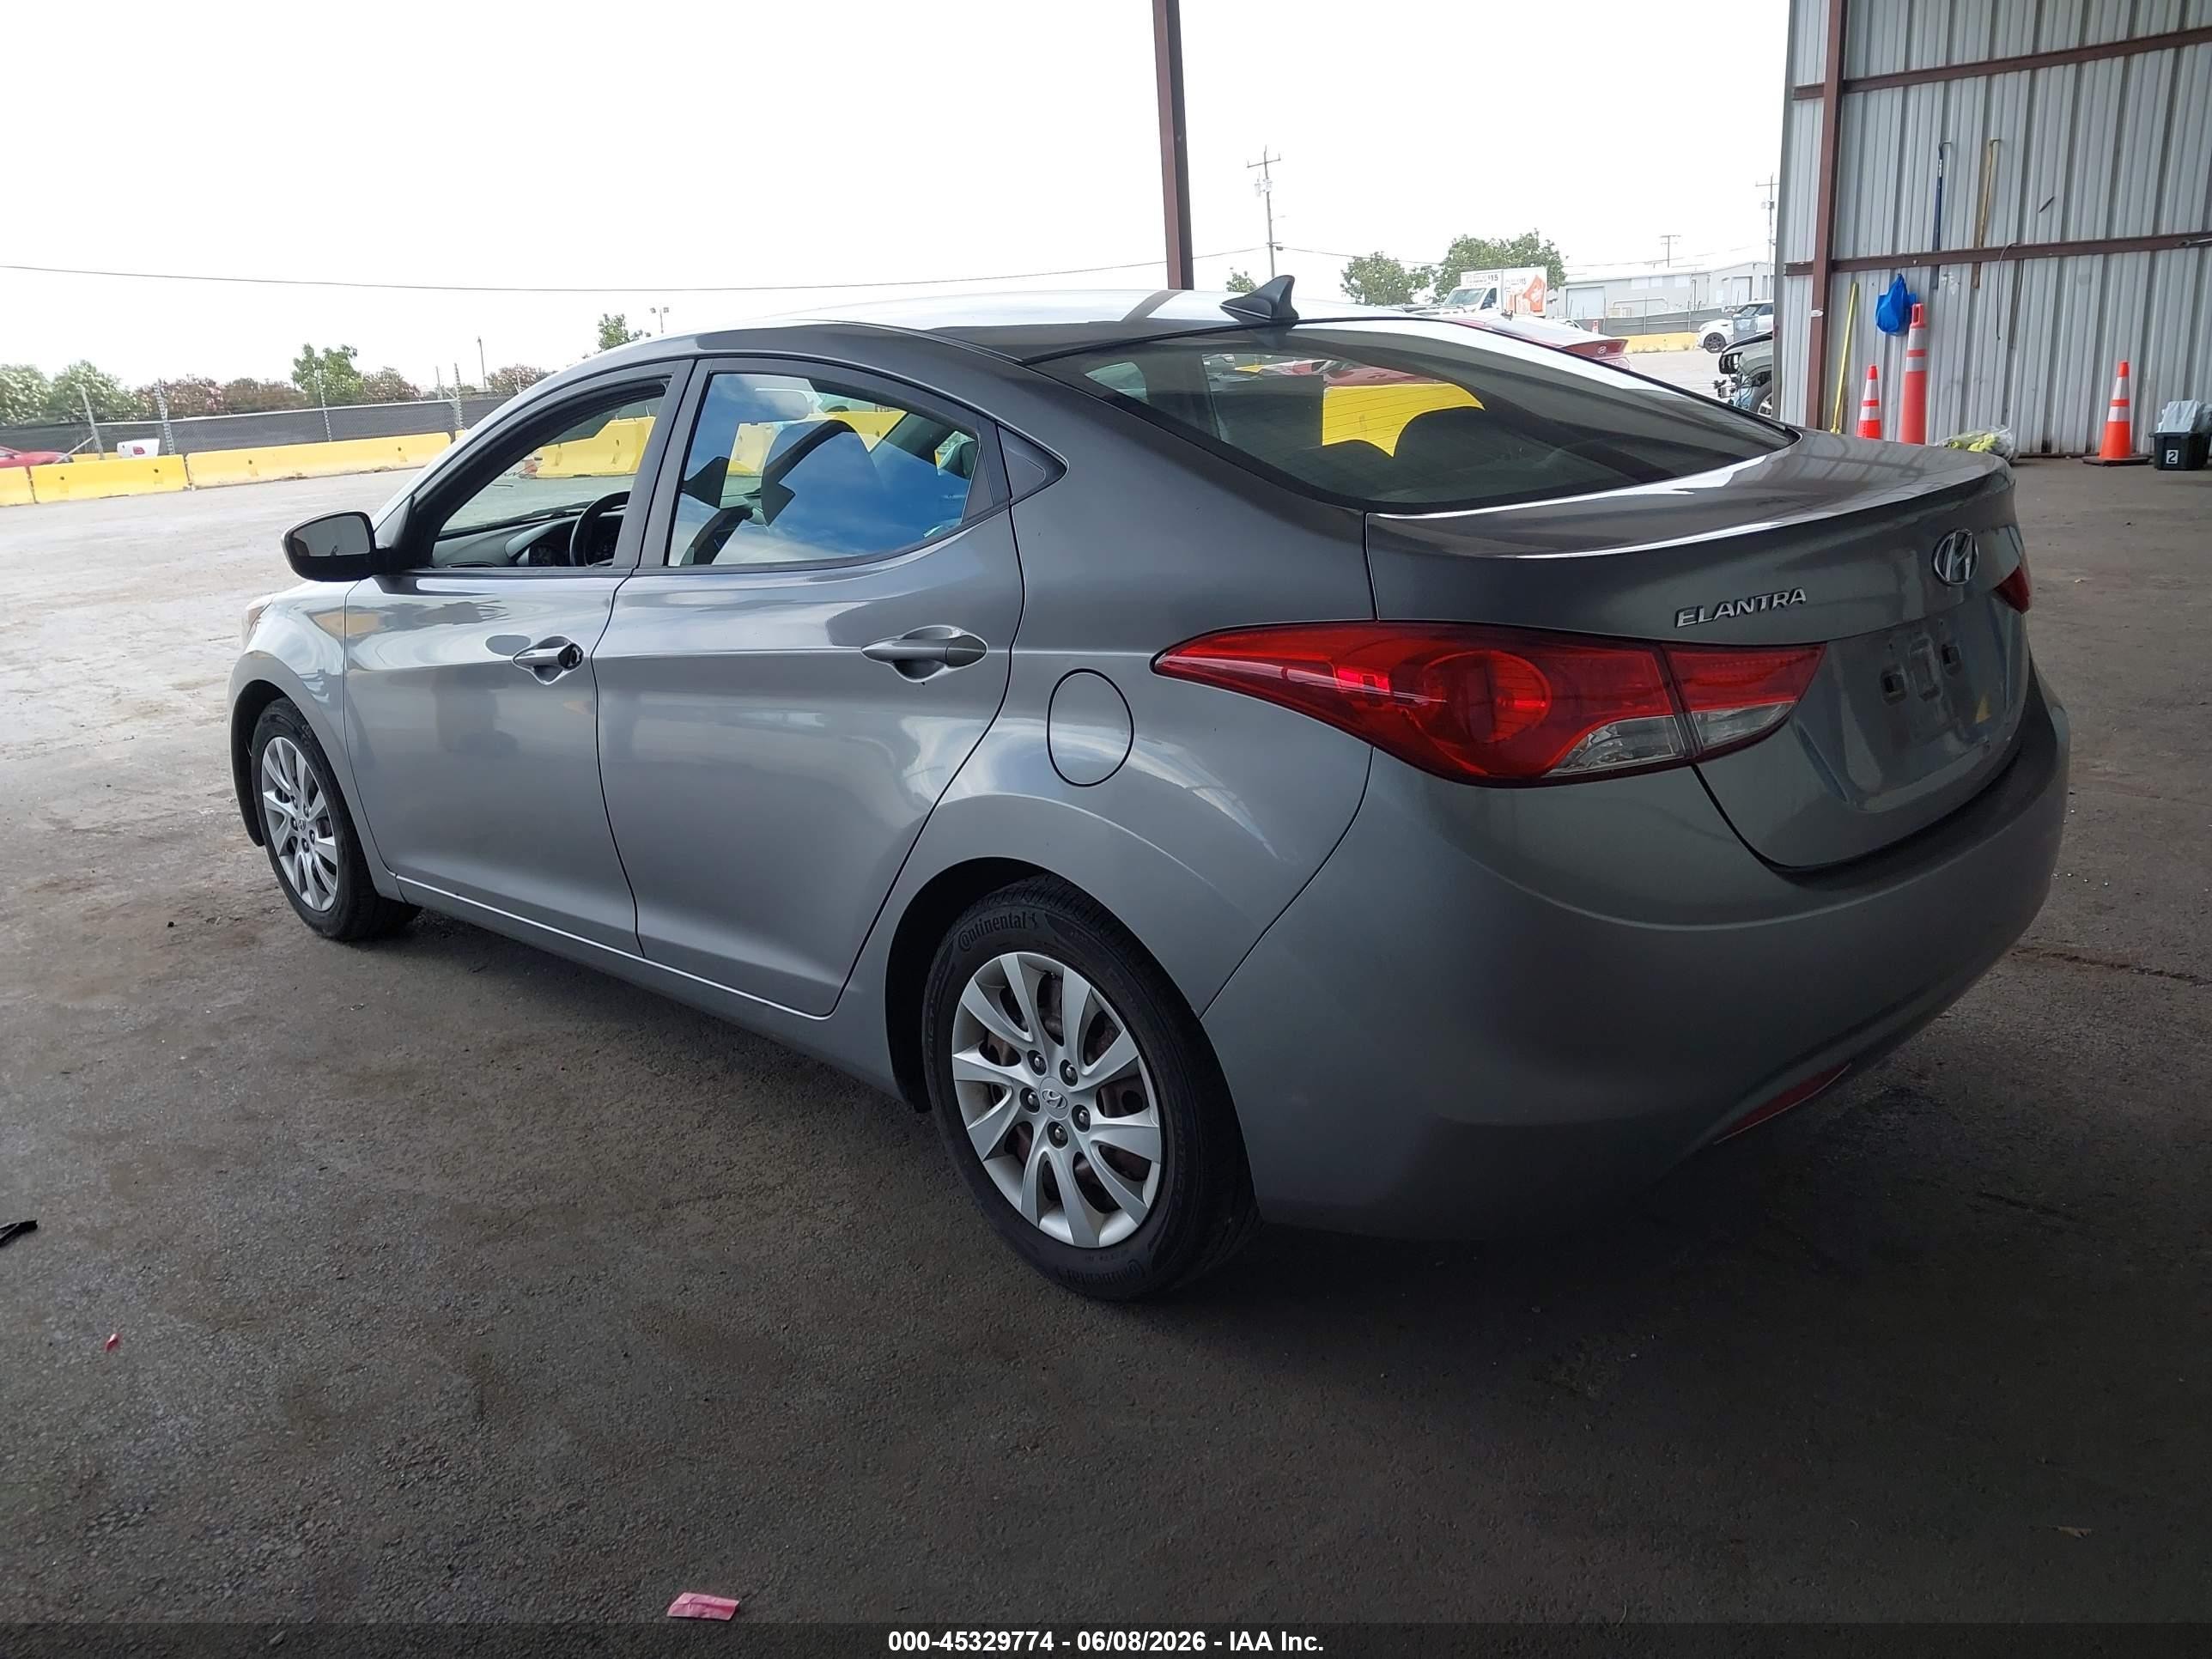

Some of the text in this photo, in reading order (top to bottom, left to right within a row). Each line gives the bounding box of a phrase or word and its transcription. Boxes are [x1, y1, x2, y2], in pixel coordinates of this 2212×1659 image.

[2168, 451, 2176, 463] 2
[1675, 587, 1807, 628] ELANTRA
[957, 911, 1027, 952] Continental
